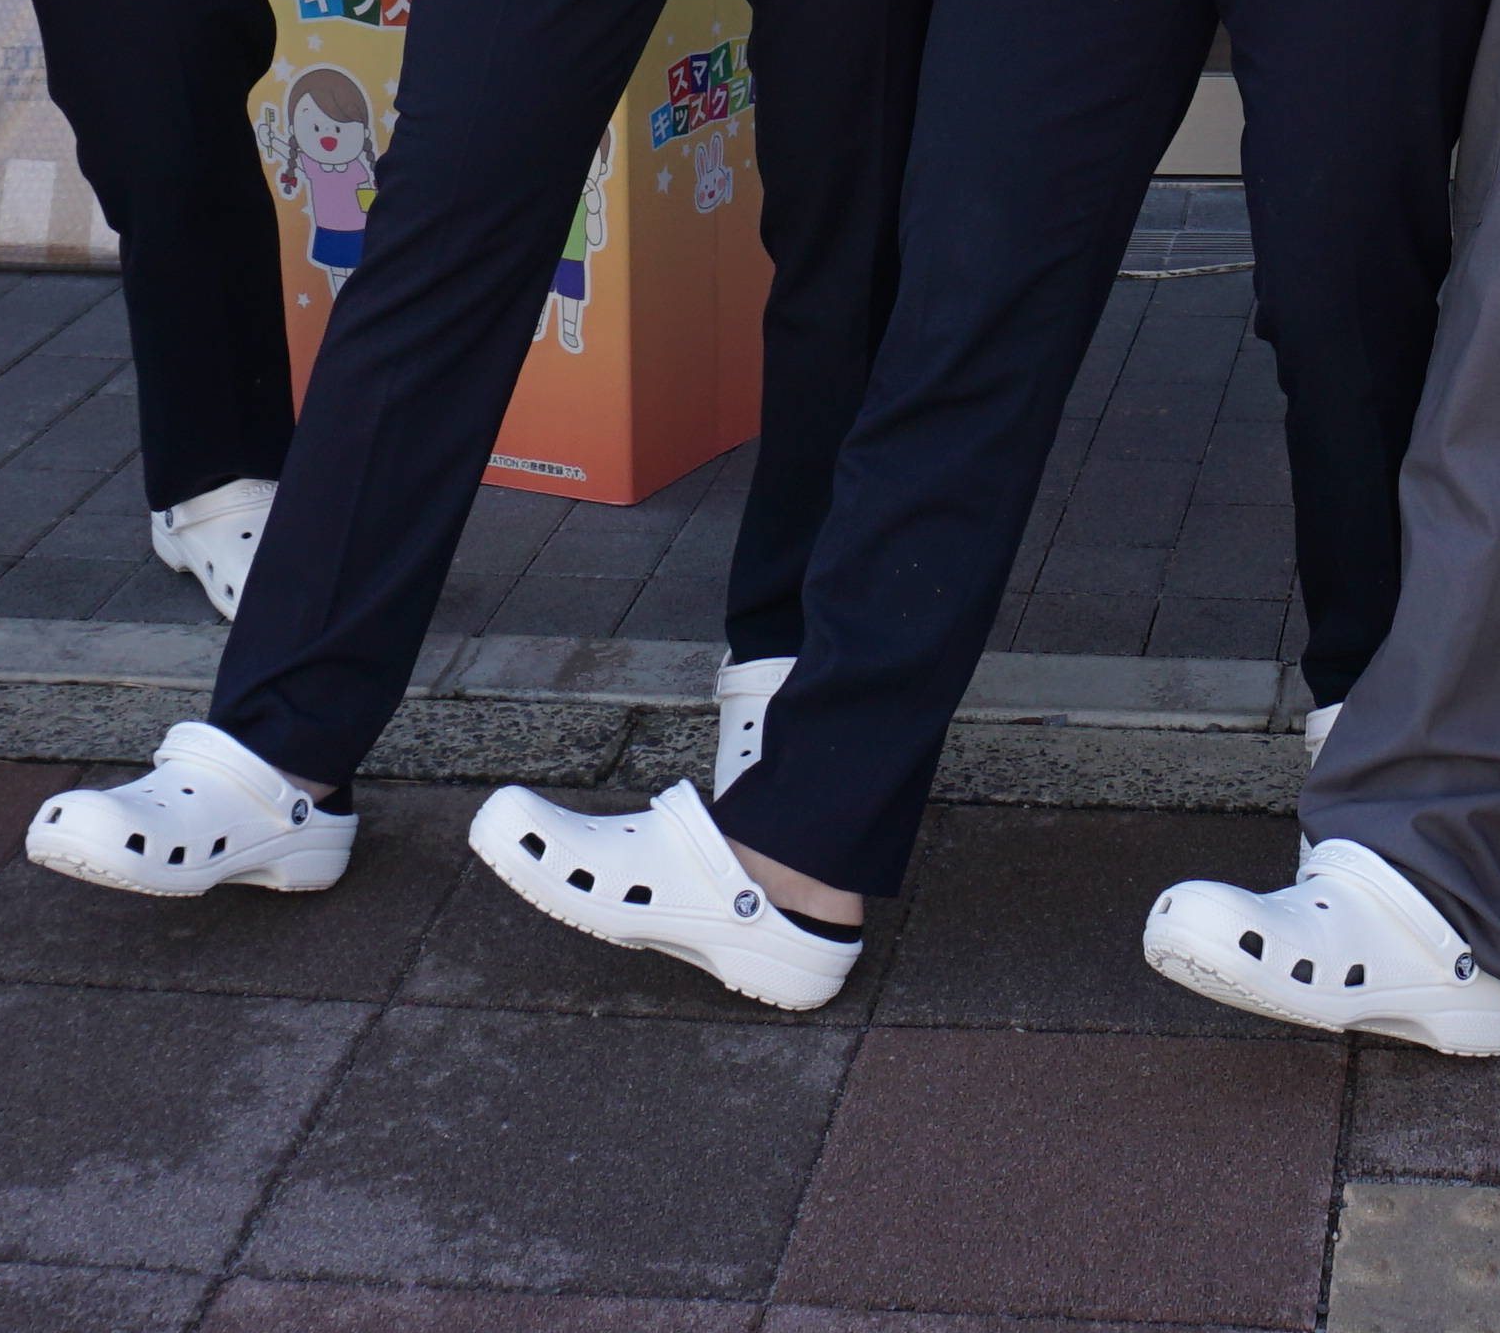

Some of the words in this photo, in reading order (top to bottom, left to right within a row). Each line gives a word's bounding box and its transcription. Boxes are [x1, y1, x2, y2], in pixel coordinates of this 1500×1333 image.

[653, 79, 757, 141] キッズクラ
